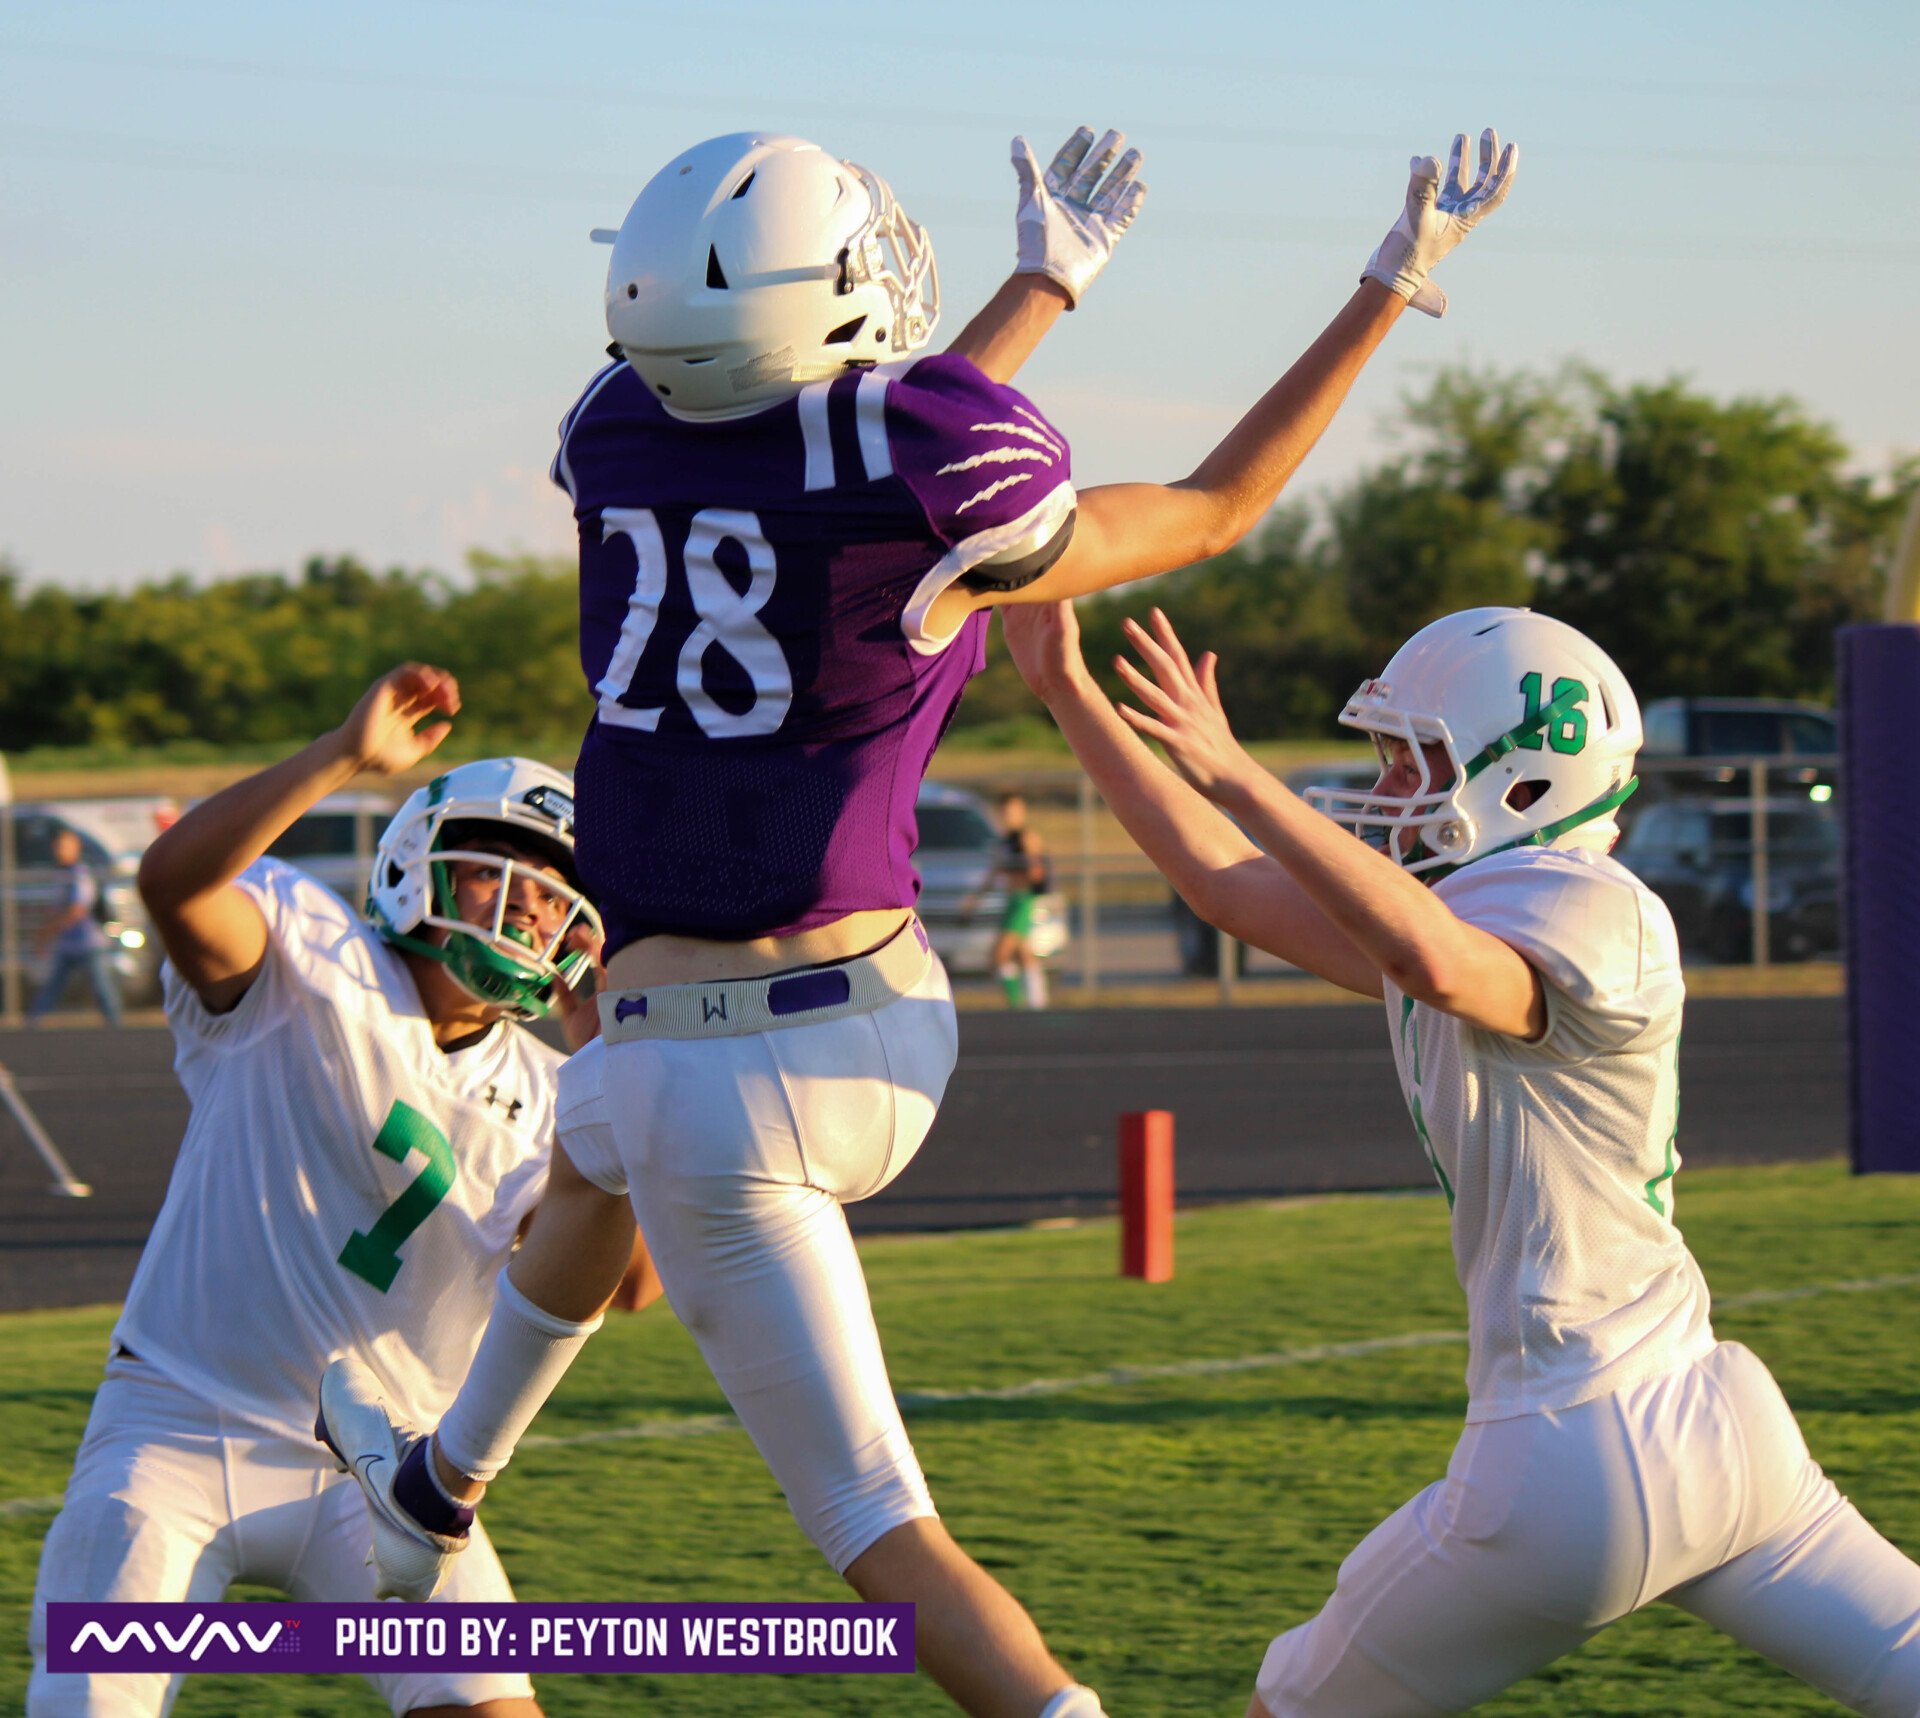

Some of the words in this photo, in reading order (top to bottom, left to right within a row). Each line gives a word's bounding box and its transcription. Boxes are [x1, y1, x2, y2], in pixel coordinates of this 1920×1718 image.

[596, 506, 793, 738] 28
[1519, 671, 1589, 755] 16
[337, 1098, 456, 1295] 7
